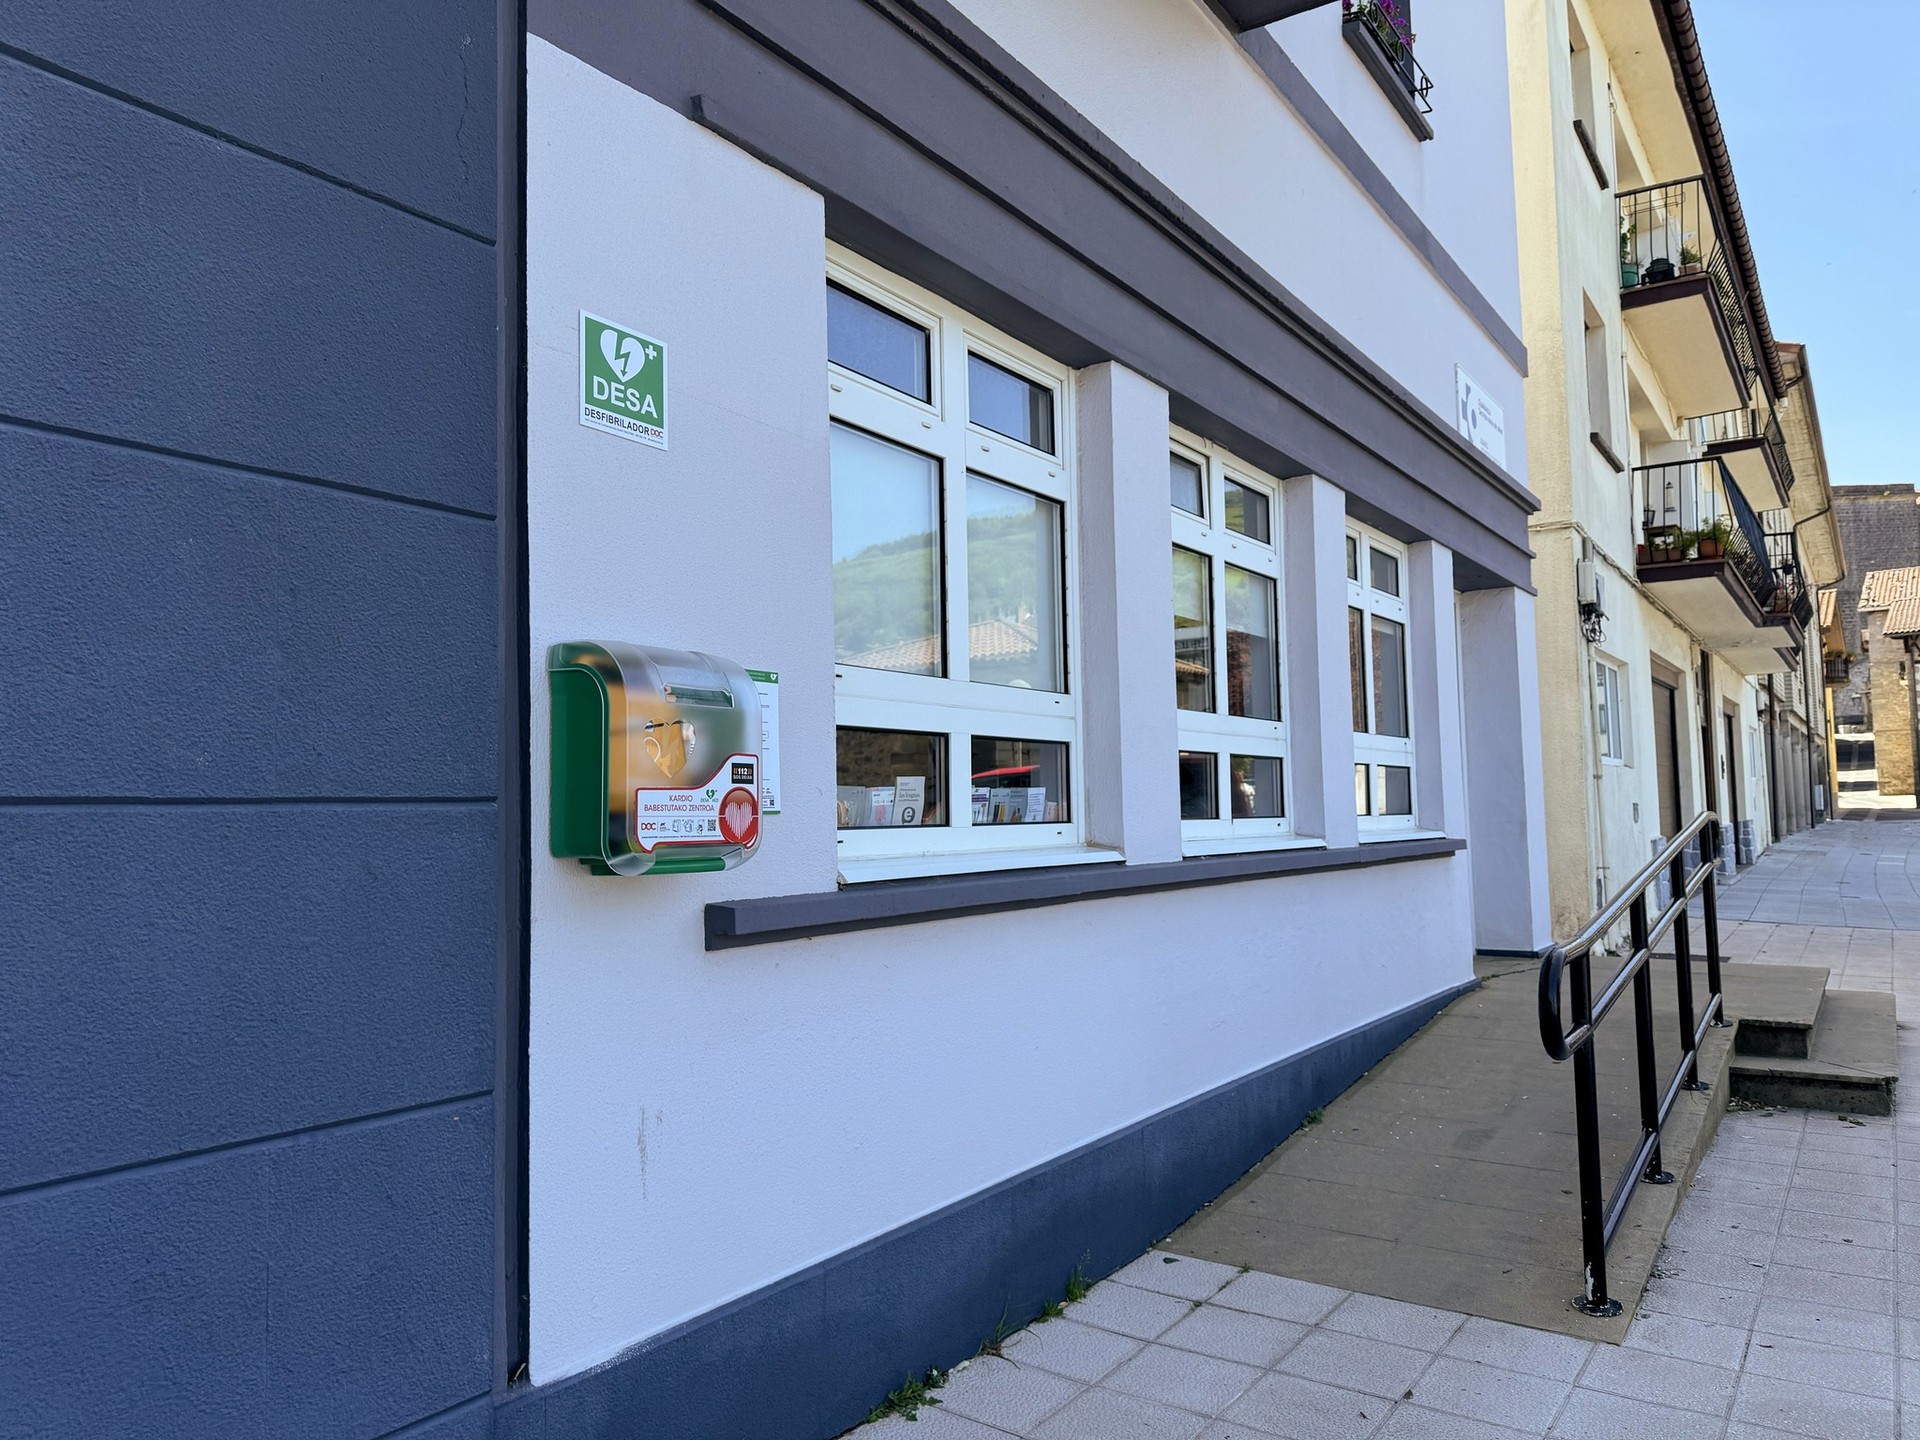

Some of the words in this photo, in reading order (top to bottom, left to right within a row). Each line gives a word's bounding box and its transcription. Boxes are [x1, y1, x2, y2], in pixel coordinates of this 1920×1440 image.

[592, 375, 658, 419] DESA
[584, 407, 650, 436] DESFIBRILADOR
[737, 767, 748, 775] 112
[644, 804, 688, 812] BABESTUTAKO
[688, 804, 715, 812] ZENTROA
